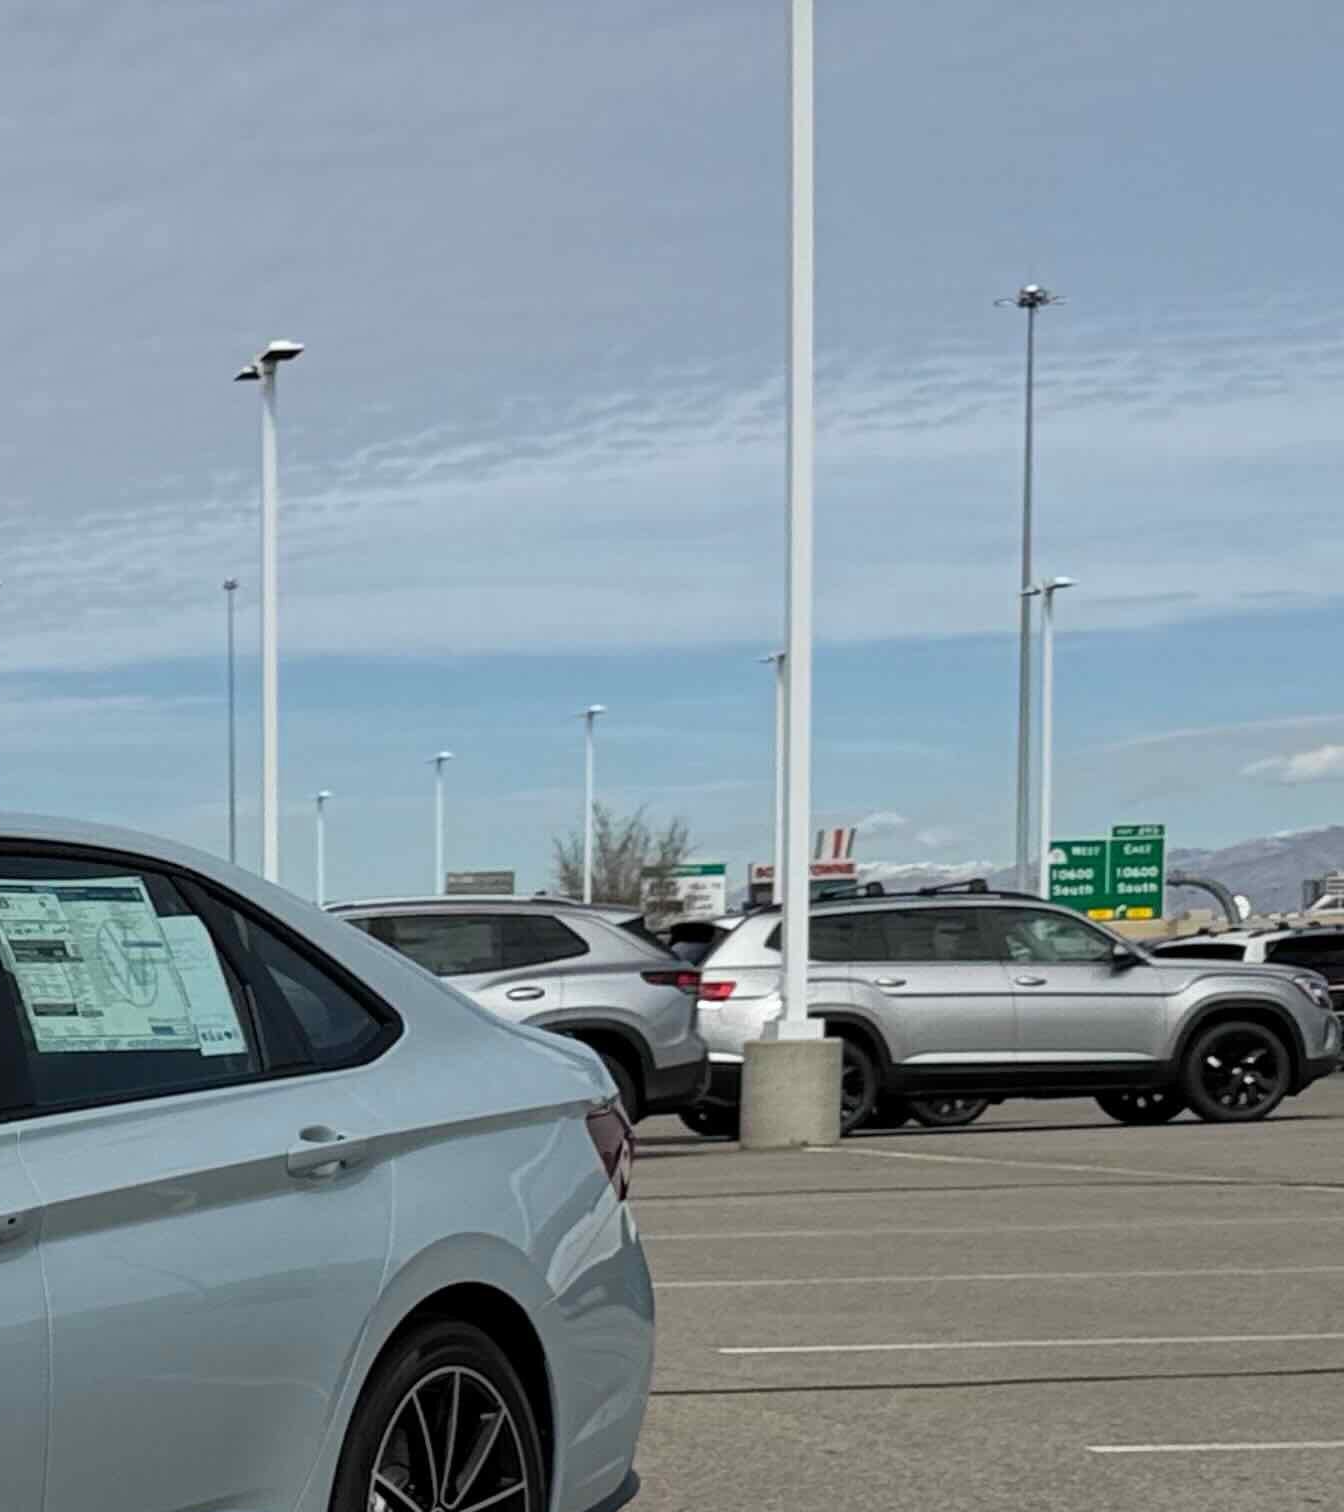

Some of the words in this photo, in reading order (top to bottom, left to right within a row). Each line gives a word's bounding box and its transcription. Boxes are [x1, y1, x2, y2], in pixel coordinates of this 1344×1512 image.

[1052, 868, 1094, 880] 10600
[1116, 866, 1159, 879] 10600
[1052, 884, 1094, 897] South
[1117, 882, 1159, 894] South
